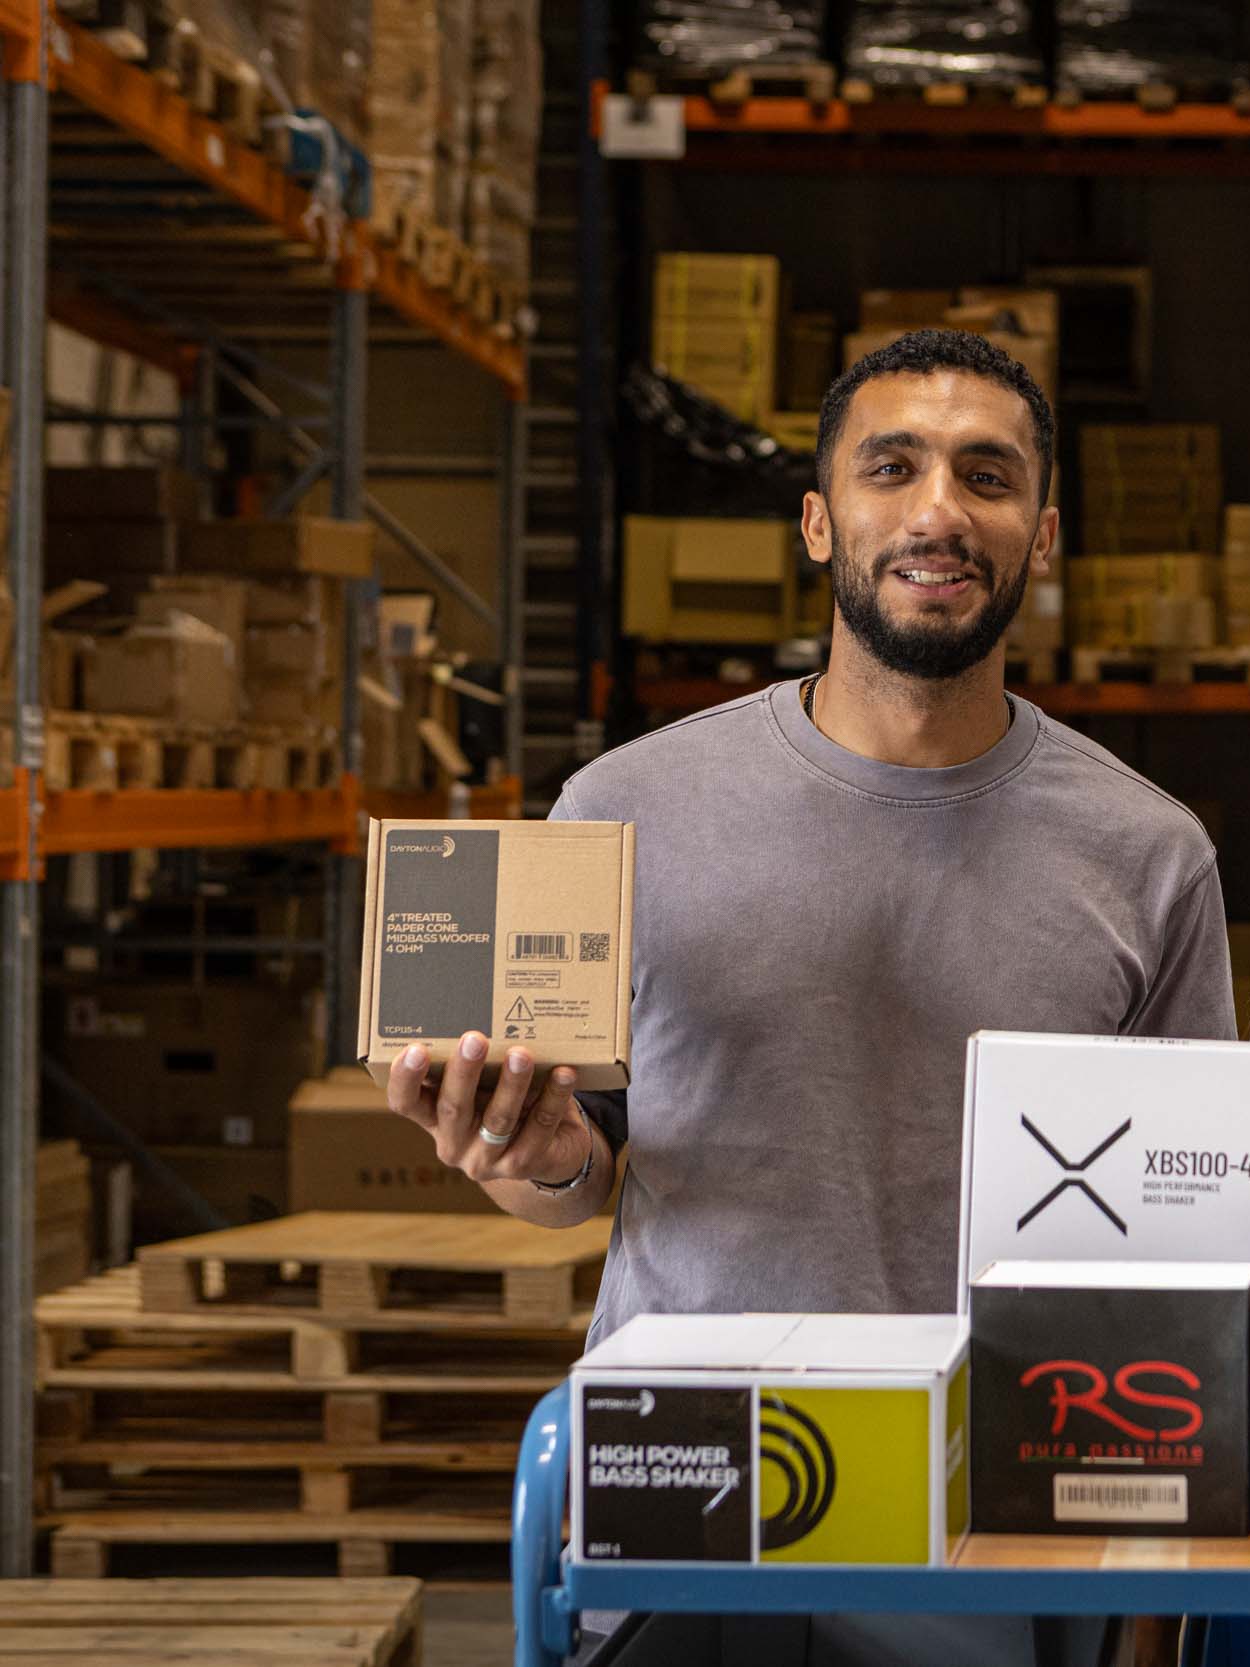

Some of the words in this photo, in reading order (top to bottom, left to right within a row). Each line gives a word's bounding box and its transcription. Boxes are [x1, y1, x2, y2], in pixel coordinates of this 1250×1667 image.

[401, 912, 452, 922] TREATED
[387, 923, 425, 933] PAPER
[426, 923, 459, 933] CONE
[386, 934, 438, 943] MIDBASS
[440, 934, 490, 943] WOOFER
[385, 944, 394, 953] 4
[395, 944, 424, 953] OHM
[384, 1025, 423, 1034] TCP115-4
[1143, 1181, 1162, 1190] HIGH
[1164, 1181, 1221, 1192] PERFORMANCE
[1142, 1194, 1162, 1204] BASS
[1164, 1195, 1195, 1205] SHAKER
[1019, 1359, 1204, 1442] RS
[589, 1444, 645, 1466] HIGH
[646, 1445, 730, 1467] POWER
[1019, 1442, 1077, 1462] pura
[1089, 1443, 1204, 1464] passione
[589, 1465, 649, 1487] BASS
[650, 1466, 740, 1488] SHAKER
